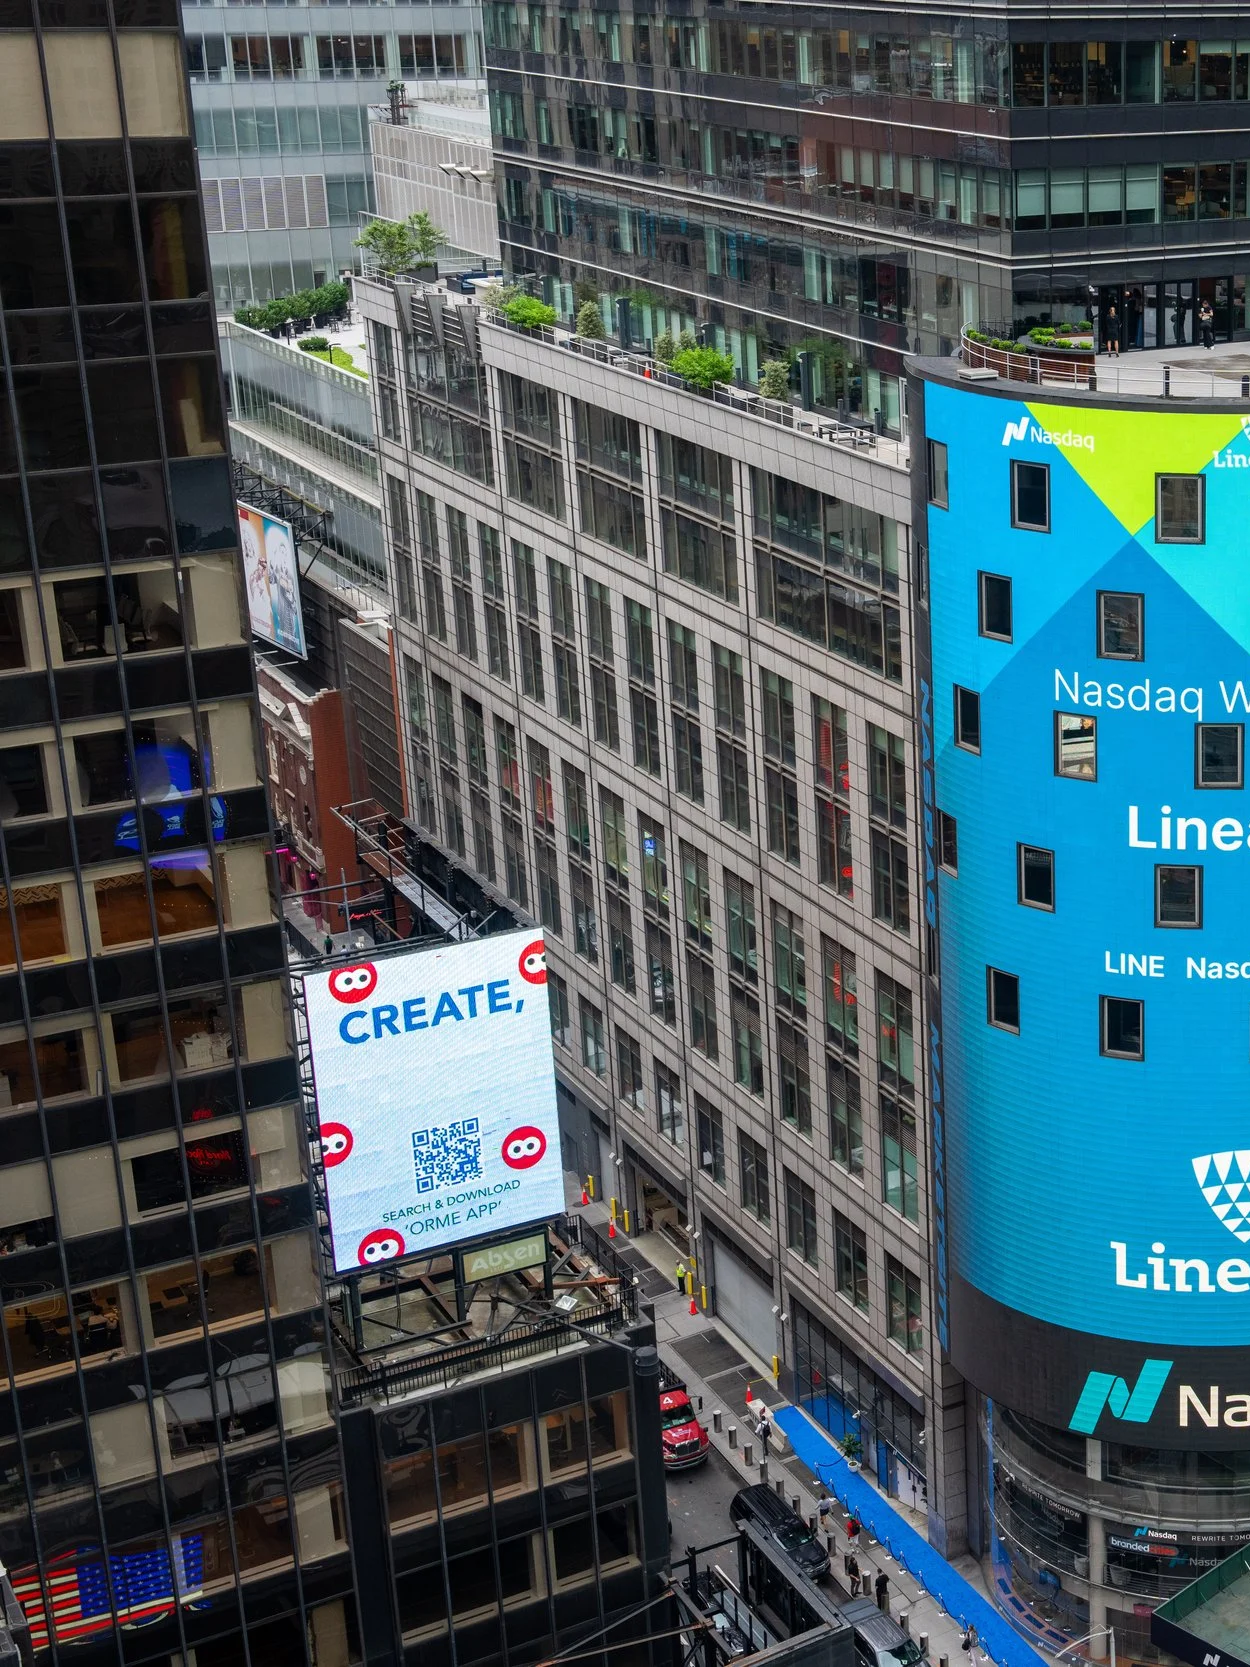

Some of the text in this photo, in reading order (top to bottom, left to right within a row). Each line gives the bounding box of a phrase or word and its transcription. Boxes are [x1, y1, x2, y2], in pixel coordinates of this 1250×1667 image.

[1031, 426, 1094, 453] Nasdaq
[1054, 668, 1204, 721] Nasdaq
[920, 677, 936, 929] NASDAQ
[1104, 950, 1164, 978] LINE
[338, 978, 524, 1045] CREATE,
[382, 1179, 521, 1223] SEARCH & DOWNLOAD
[470, 1242, 540, 1274] Absen
[1147, 1529, 1178, 1541] Nasdaq
[1189, 1556, 1223, 1567] Nasda
